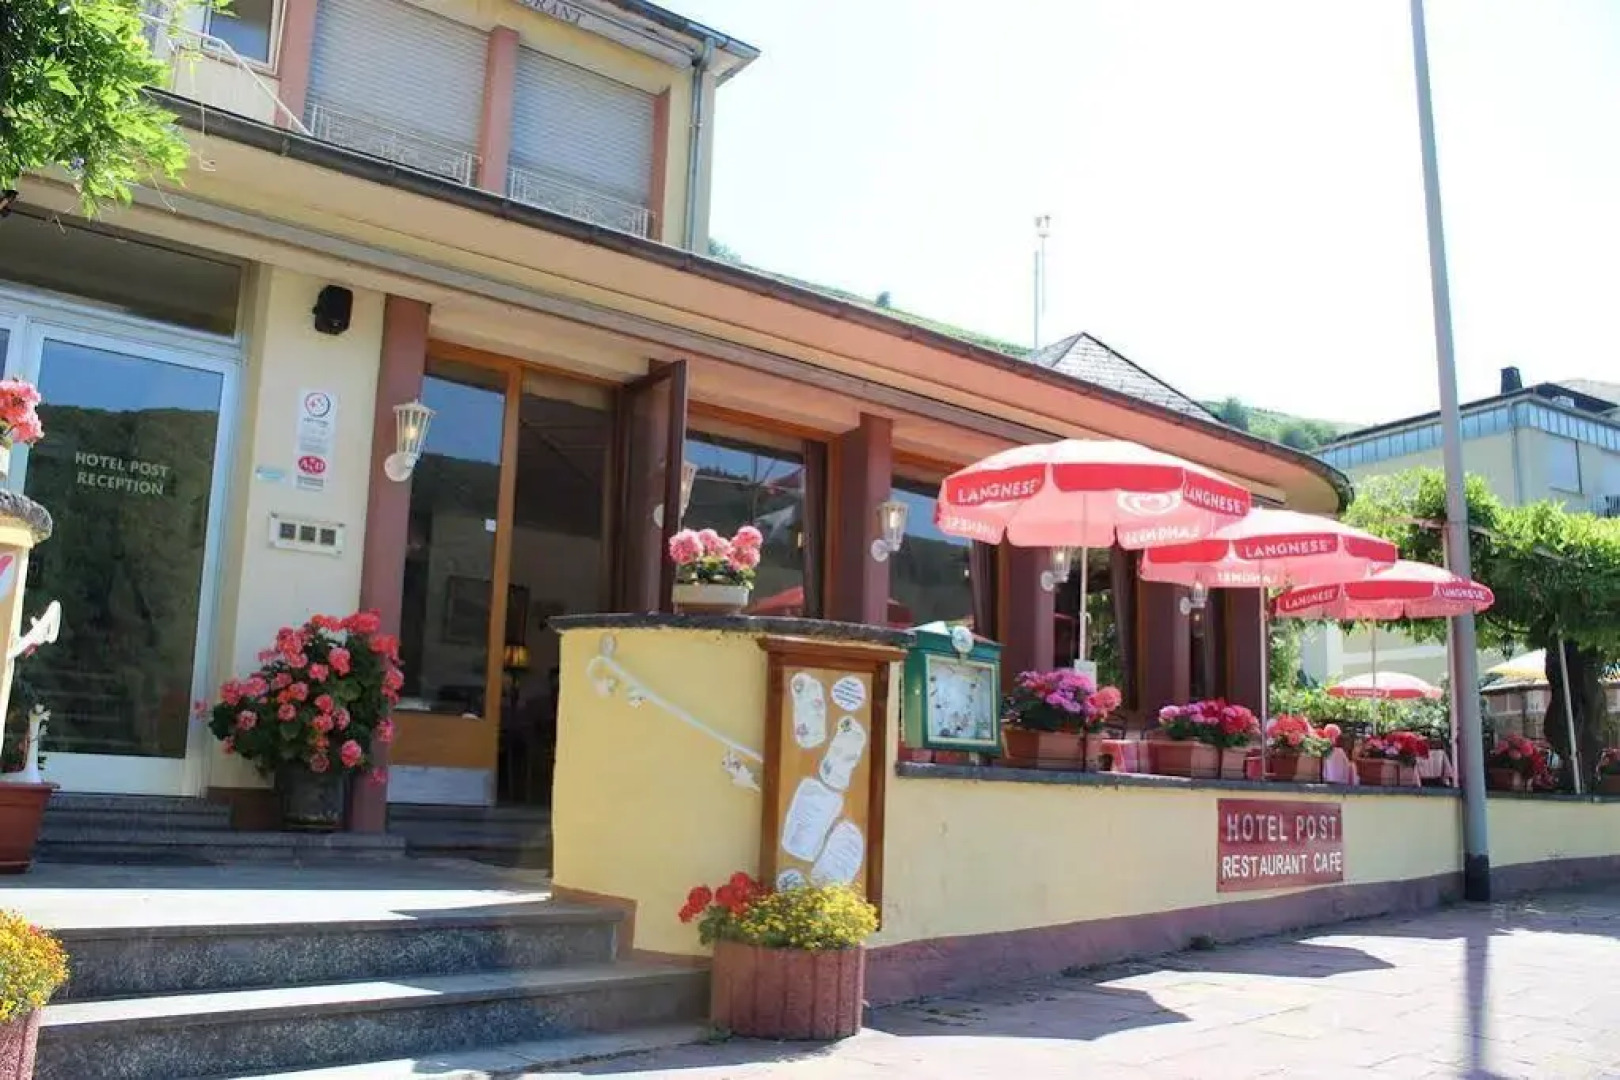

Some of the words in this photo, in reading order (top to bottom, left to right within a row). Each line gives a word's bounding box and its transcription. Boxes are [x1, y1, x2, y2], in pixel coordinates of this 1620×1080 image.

[75, 451, 126, 471] HOTEL
[130, 460, 171, 478] POST
[77, 471, 164, 495] RECEPTION
[957, 479, 1036, 503] LANGNESE
[1183, 479, 1242, 514] LANGNESE
[1245, 539, 1329, 558] LANGNESE
[1226, 813, 1288, 842] HOTEL
[1296, 814, 1337, 840] POST
[1222, 854, 1308, 879] RESTAURANT
